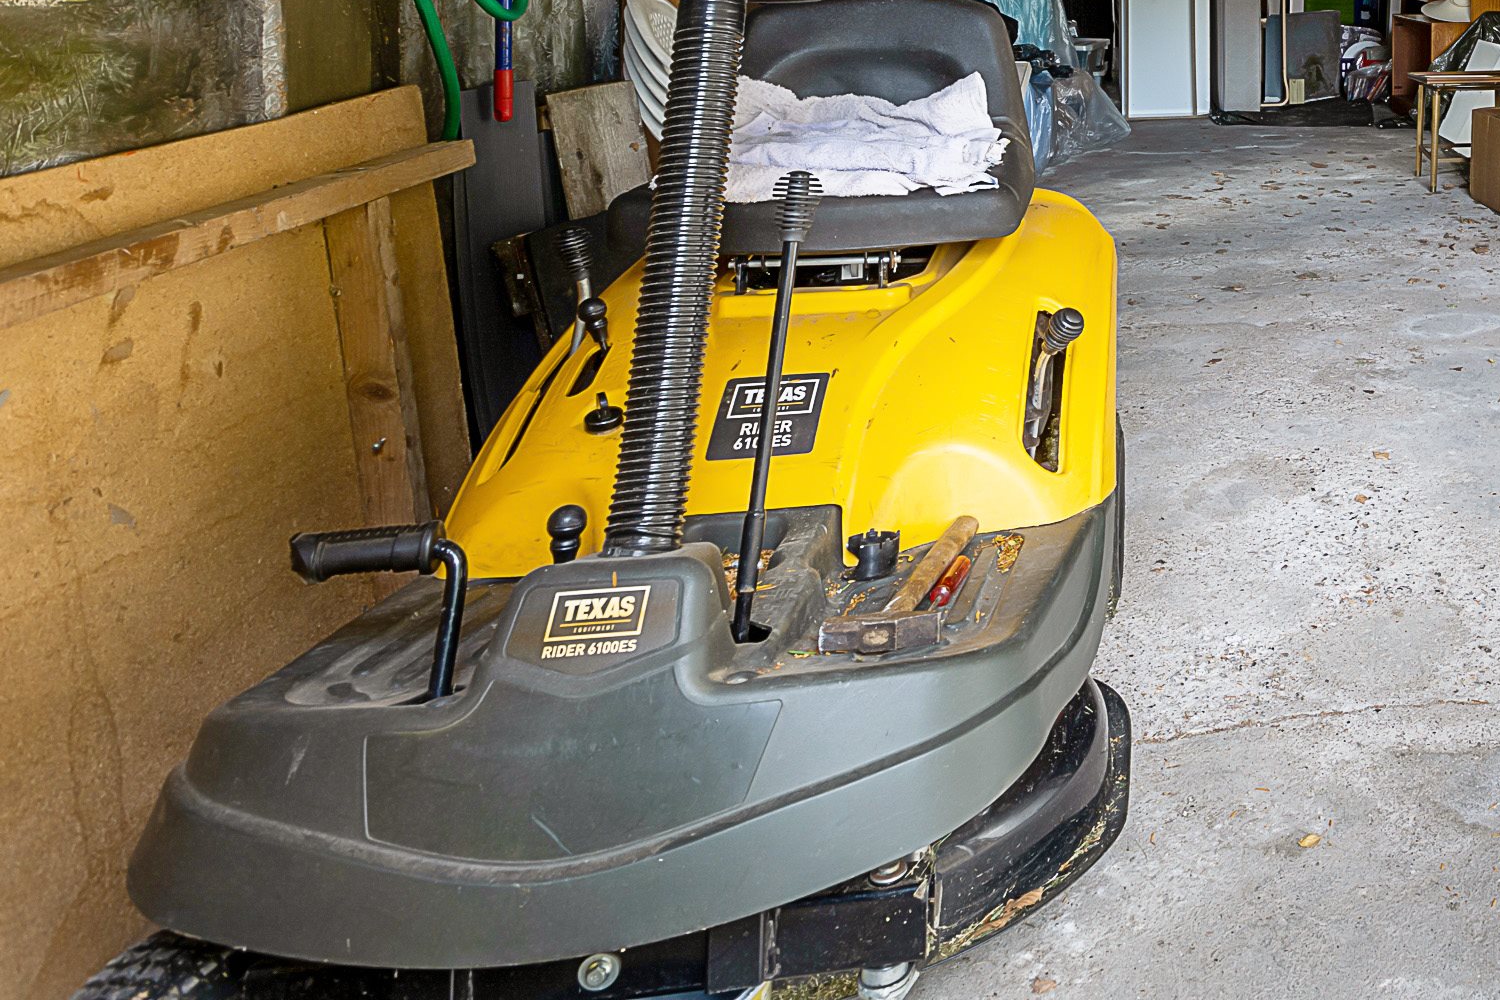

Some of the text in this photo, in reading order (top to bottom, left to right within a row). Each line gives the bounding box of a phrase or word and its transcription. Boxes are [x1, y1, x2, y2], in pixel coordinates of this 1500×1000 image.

[744, 386, 807, 404] TEAS
[740, 420, 792, 435] RIER
[564, 596, 635, 622] TEXAS
[541, 639, 637, 660] RIDER 6100ES
